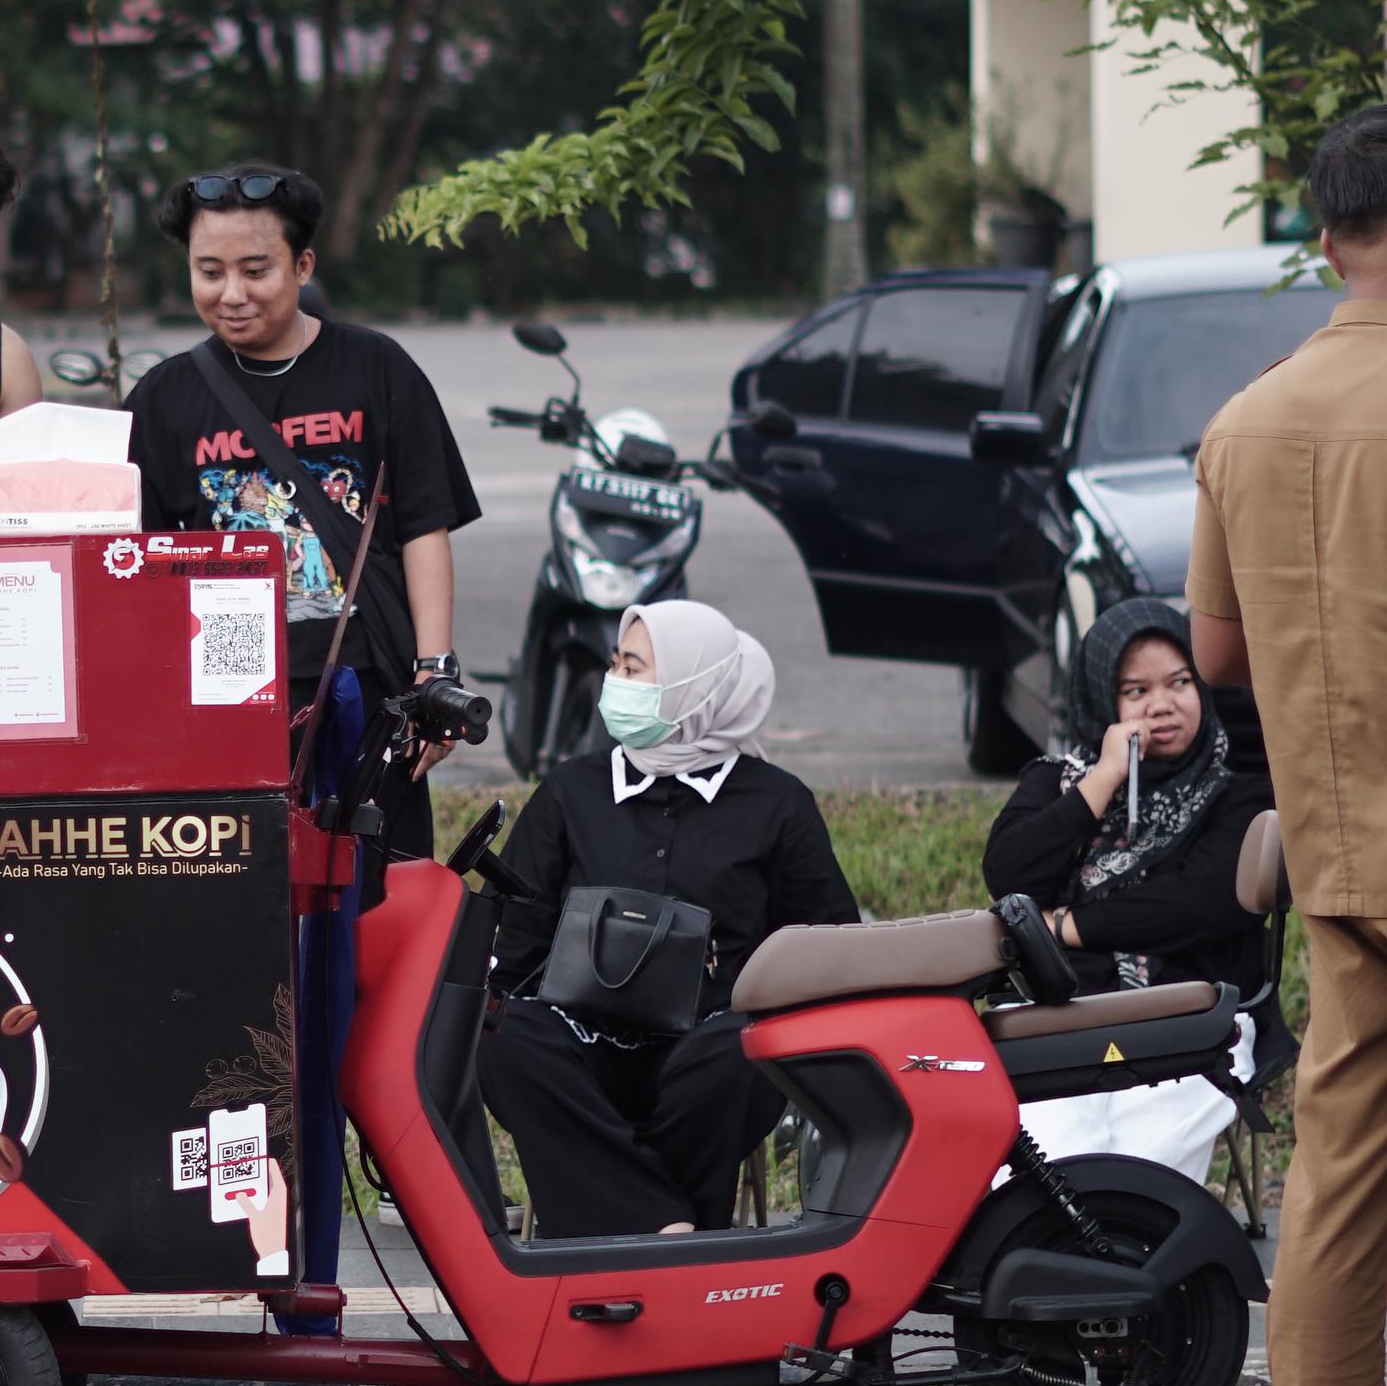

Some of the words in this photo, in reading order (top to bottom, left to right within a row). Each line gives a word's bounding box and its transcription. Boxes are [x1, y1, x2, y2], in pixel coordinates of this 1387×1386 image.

[196, 411, 364, 466] MOFEM
[33, 864, 68, 877] Rasa
[71, 863, 106, 879] Yang
[110, 863, 134, 876] Tak
[137, 862, 167, 875] Bisa
[705, 1283, 784, 1304] EXOTIC
